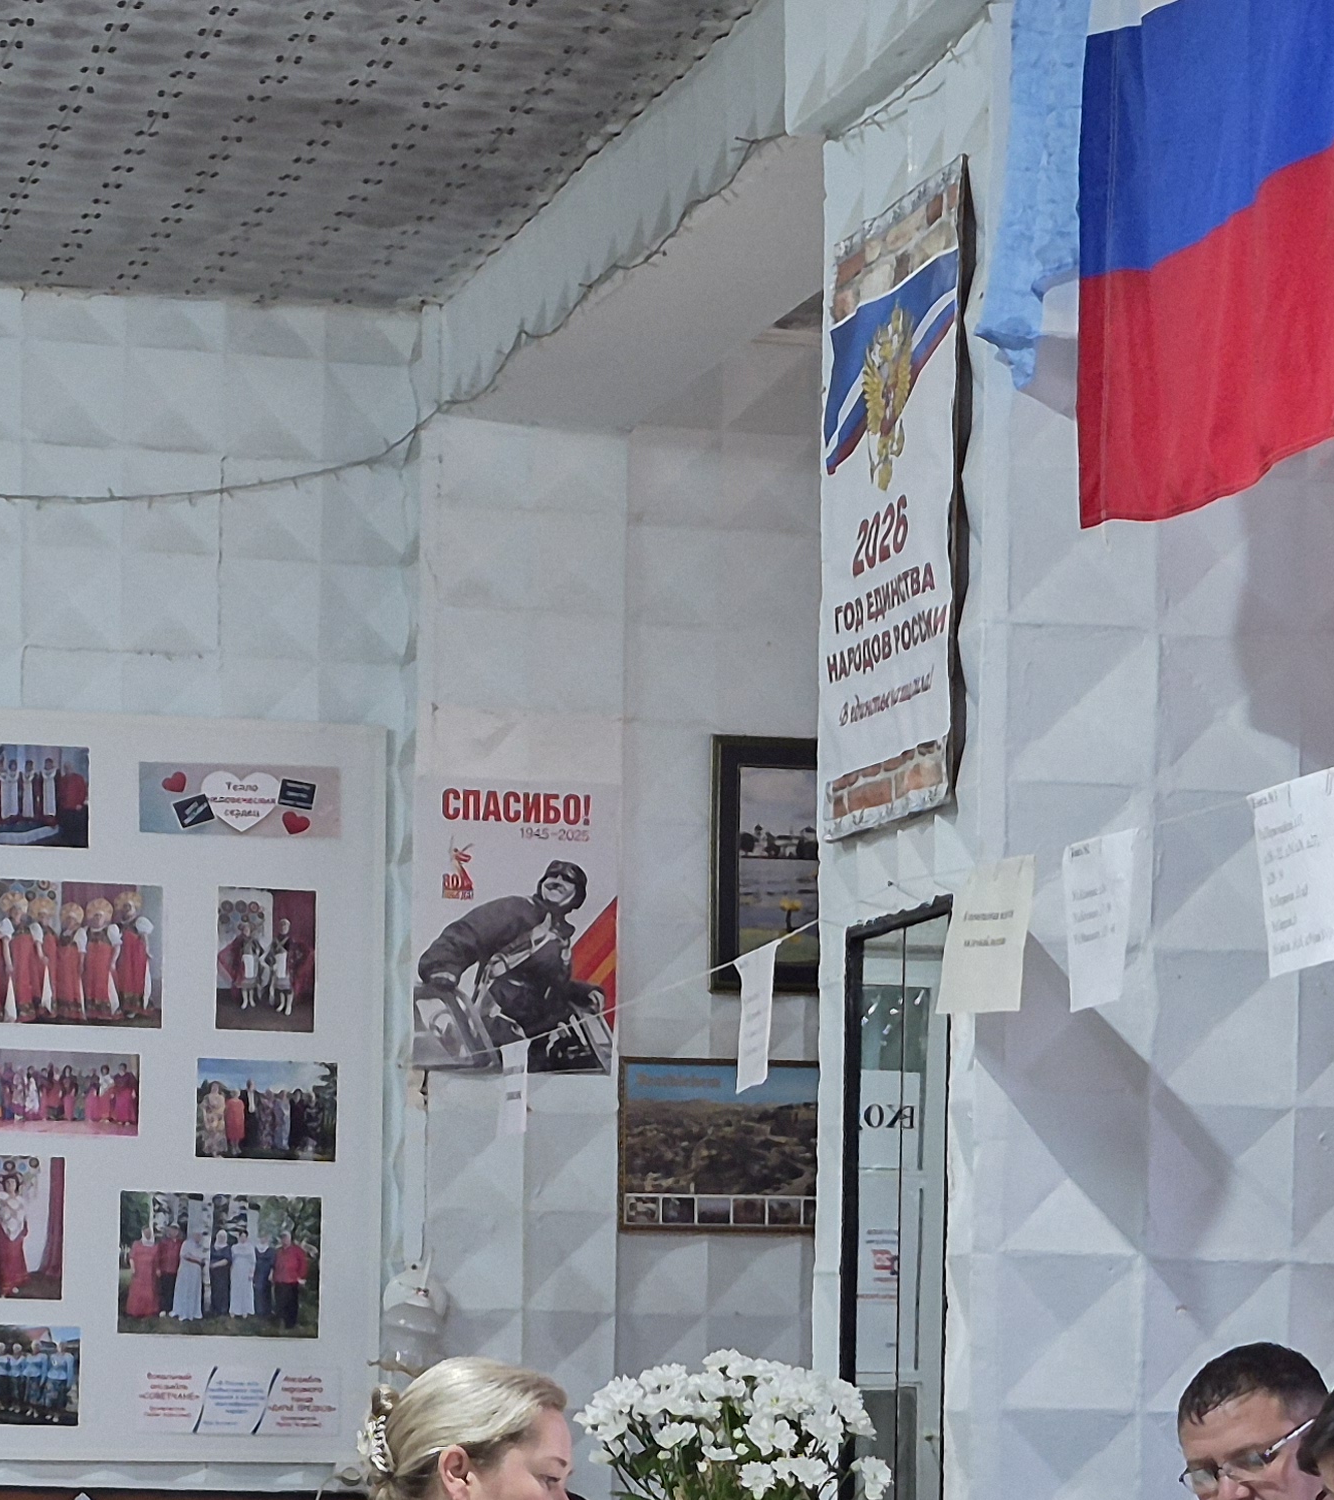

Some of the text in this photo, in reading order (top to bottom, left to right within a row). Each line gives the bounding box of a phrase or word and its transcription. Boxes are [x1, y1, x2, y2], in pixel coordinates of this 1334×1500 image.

[852, 494, 909, 578] 2026
[834, 562, 936, 634] ГОД ЕДИНСТВА
[827, 604, 947, 684] НАРОДОВ РОССИИ
[442, 788, 592, 826] СПАСИБО!
[519, 827, 591, 843] 1945-2025
